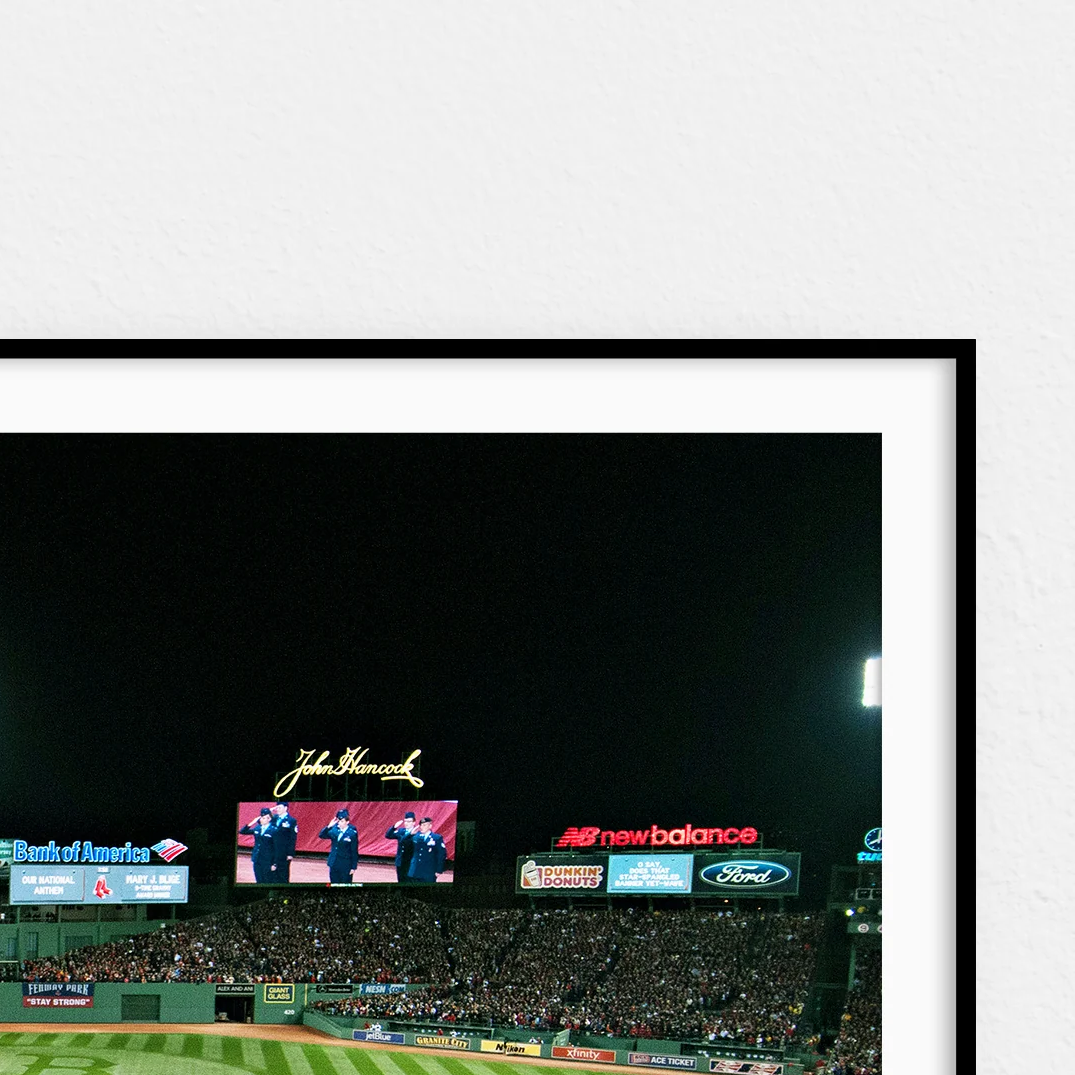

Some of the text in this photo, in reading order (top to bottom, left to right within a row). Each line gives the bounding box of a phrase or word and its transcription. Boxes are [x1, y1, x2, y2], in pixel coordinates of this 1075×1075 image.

[273, 746, 425, 798] John Hancock
[13, 839, 151, 862] Bank of America
[543, 867, 602, 877] DUNKIN'
[716, 865, 773, 884] Ford
[22, 875, 76, 885] OUR NATIONAL
[125, 874, 149, 884] MARY
[543, 877, 598, 887] DONUTS
[28, 983, 89, 996] FENWAY PARK
[365, 1031, 392, 1041] jetBlue
[416, 1036, 450, 1046] GRANITE
[450, 1038, 468, 1049] CITY
[566, 1048, 601, 1061] xfinity
[650, 1056, 667, 1065] ACE
[667, 1057, 695, 1067] TICKET
